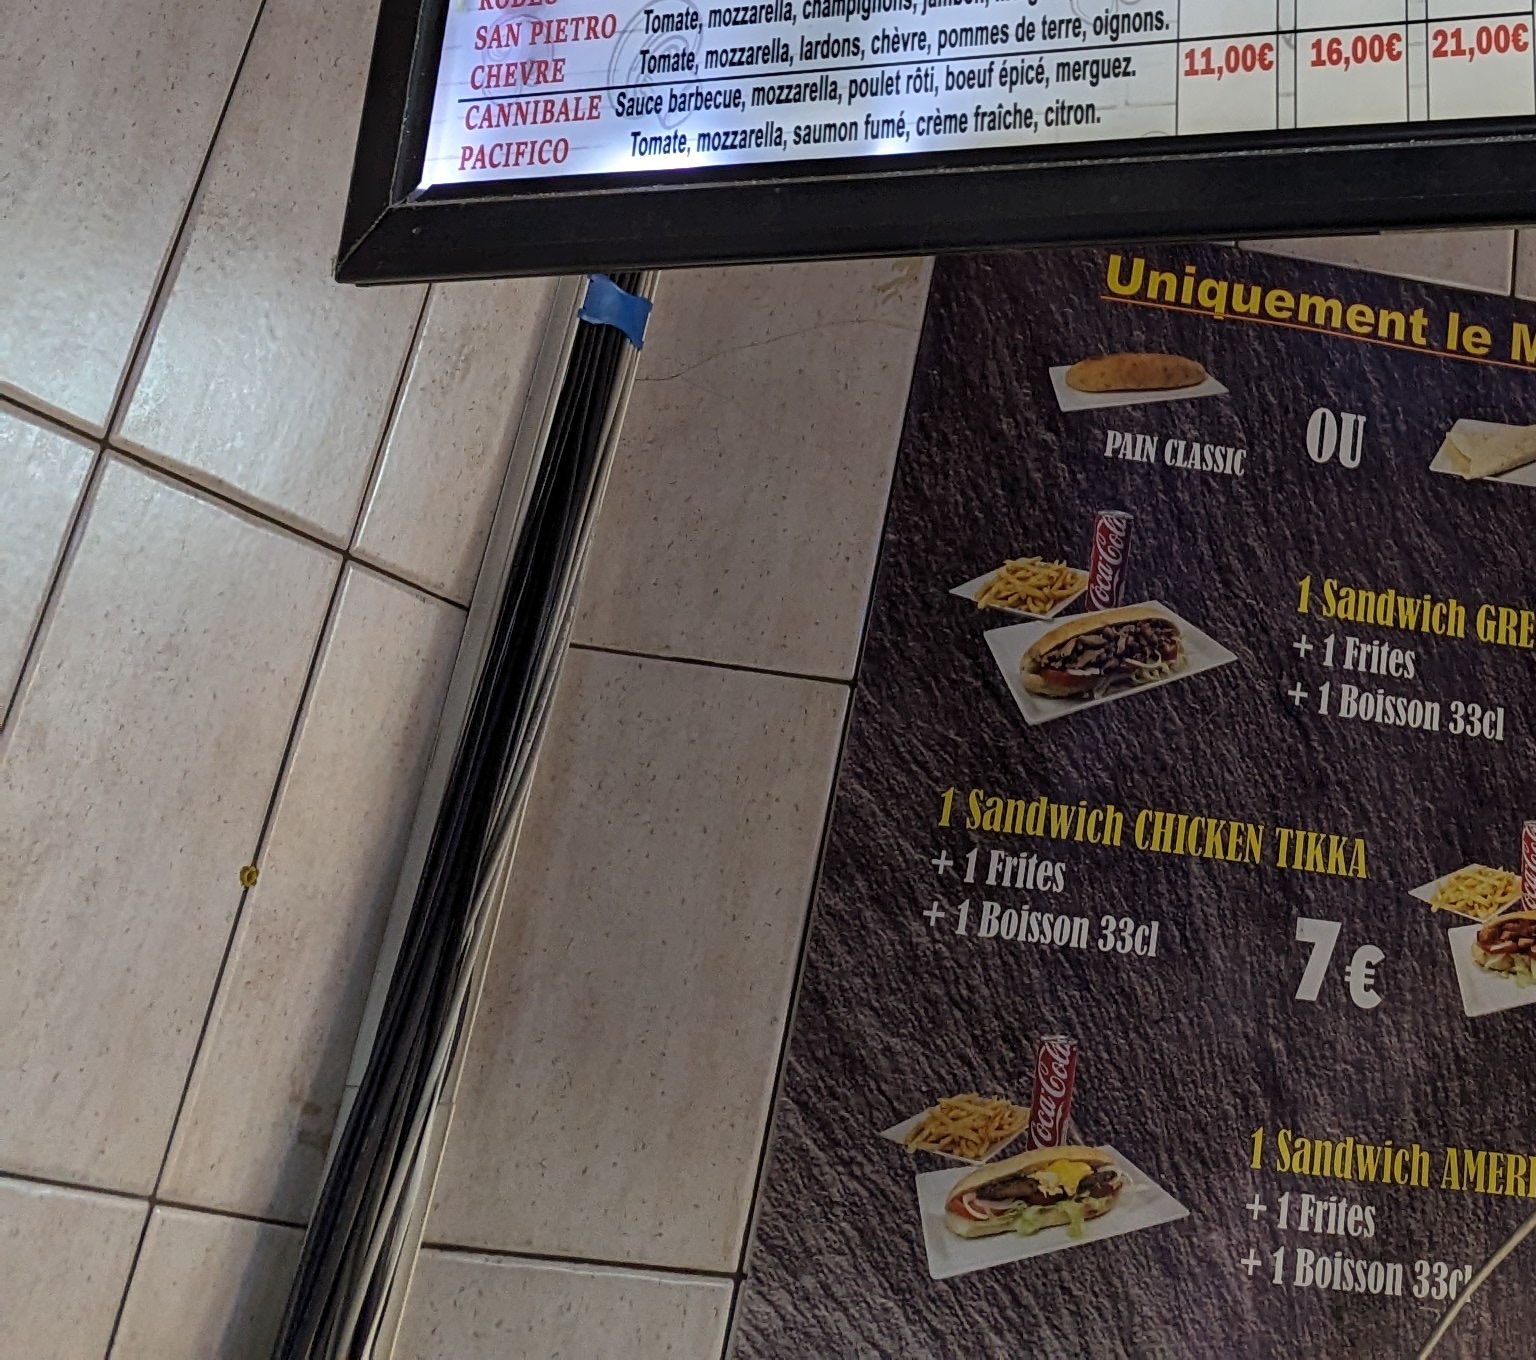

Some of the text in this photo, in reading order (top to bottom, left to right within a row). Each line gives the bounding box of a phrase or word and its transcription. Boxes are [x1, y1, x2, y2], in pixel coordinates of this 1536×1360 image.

[475, 13, 618, 50] SAN PIETRO
[1183, 22, 1529, 80] 11,00€ 16,00€ 21,00€
[470, 58, 565, 89] CHEVRE
[465, 95, 601, 131] CANNIBALE
[459, 138, 570, 171] PACIFICO
[1106, 254, 1428, 346] Uniquement
[1447, 312, 1492, 356] le
[1104, 430, 1248, 477] PAIN CLASSIC
[1306, 407, 1367, 469] OU
[1297, 575, 1312, 613] 1
[1322, 578, 1466, 639] Sandwich
[1323, 633, 1335, 667] 1
[1343, 636, 1416, 679] Frites
[1318, 681, 1331, 715] 1
[1338, 685, 1440, 731] Boisson
[1448, 700, 1505, 741] 33cl
[937, 787, 1368, 879] 1 Sandwich CHICKEN TIKKA
[963, 847, 978, 883] 1
[985, 849, 1067, 894] Frites
[955, 899, 970, 935] 1
[978, 900, 1090, 950] Boisson
[1097, 914, 1159, 958] 33cl
[1250, 1127, 1265, 1170] 1
[1276, 1129, 1430, 1188] Sandwich
[1277, 1191, 1290, 1230] 1
[1299, 1194, 1376, 1238] Frites
[1271, 1246, 1285, 1286] 1
[1293, 1248, 1403, 1296] Boisson
